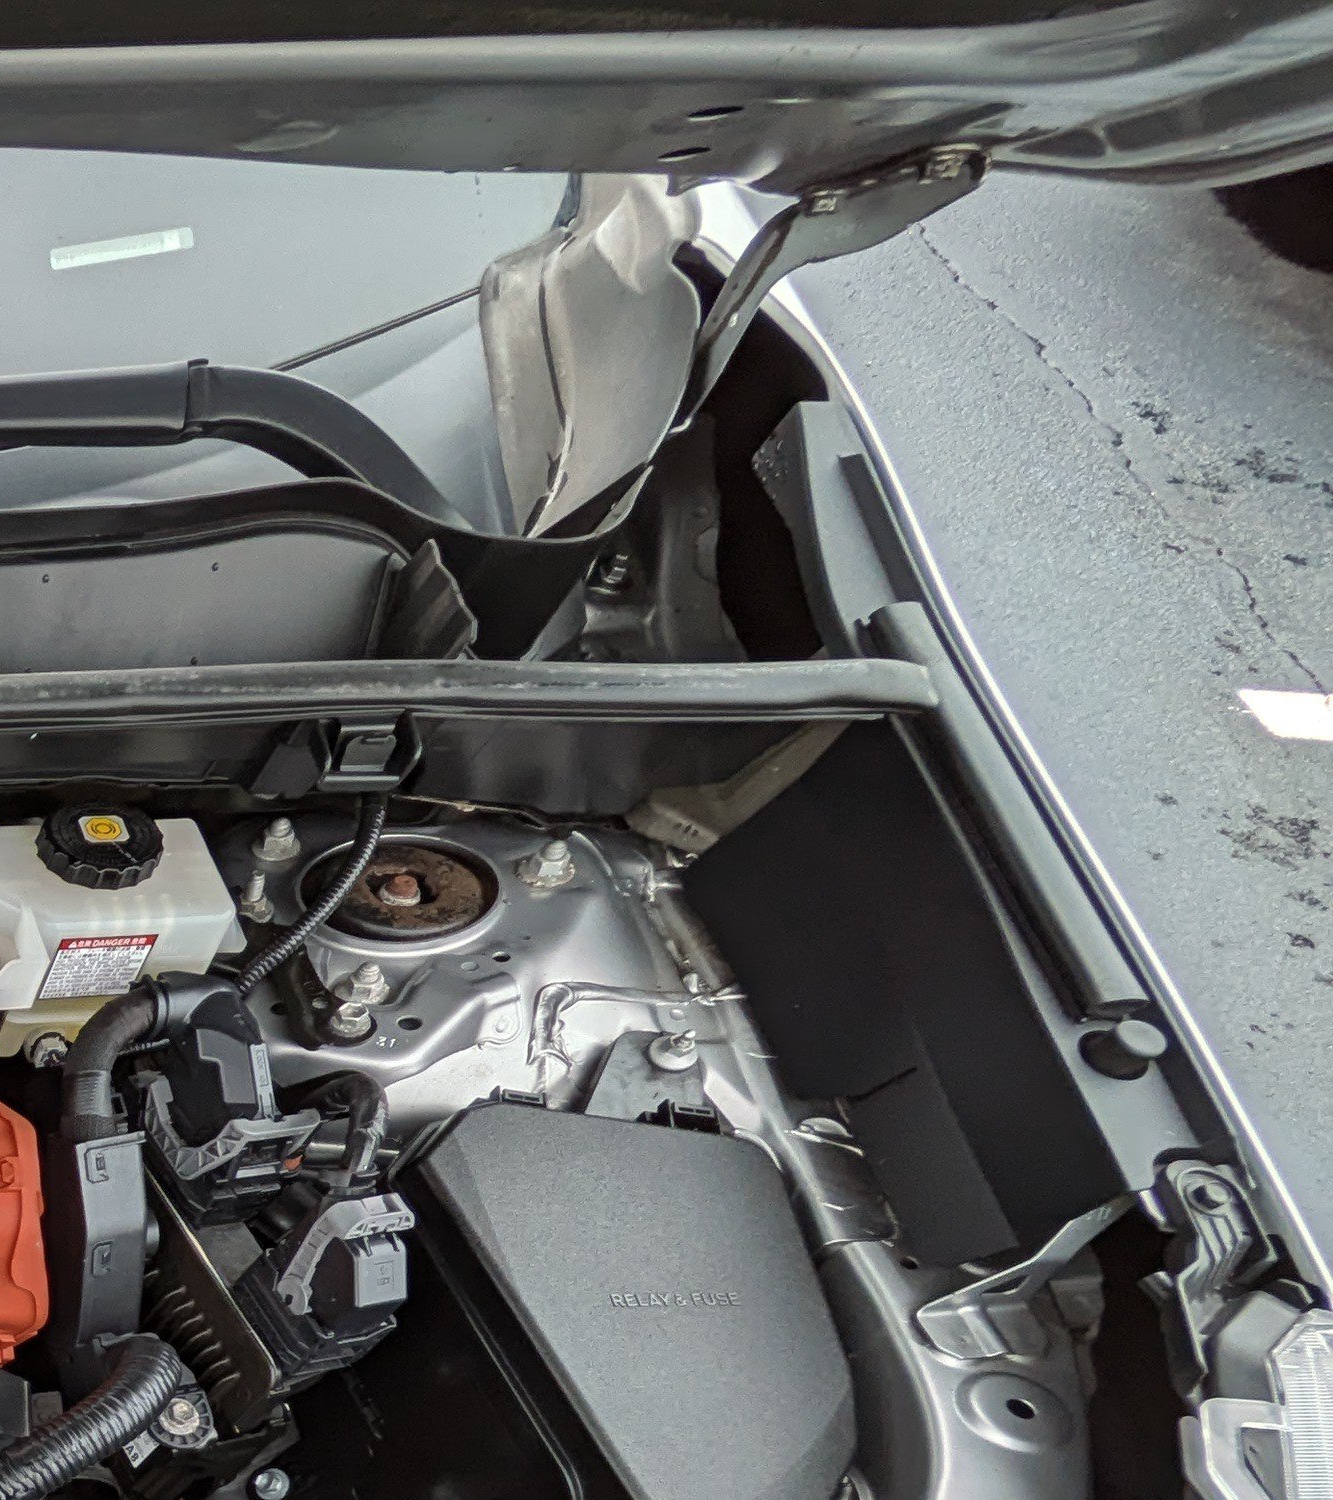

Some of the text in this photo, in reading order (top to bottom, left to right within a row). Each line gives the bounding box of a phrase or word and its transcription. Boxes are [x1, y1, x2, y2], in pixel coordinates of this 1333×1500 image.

[92, 938, 131, 947] DANGER
[610, 1292, 742, 1307] RELAY & FUSE
